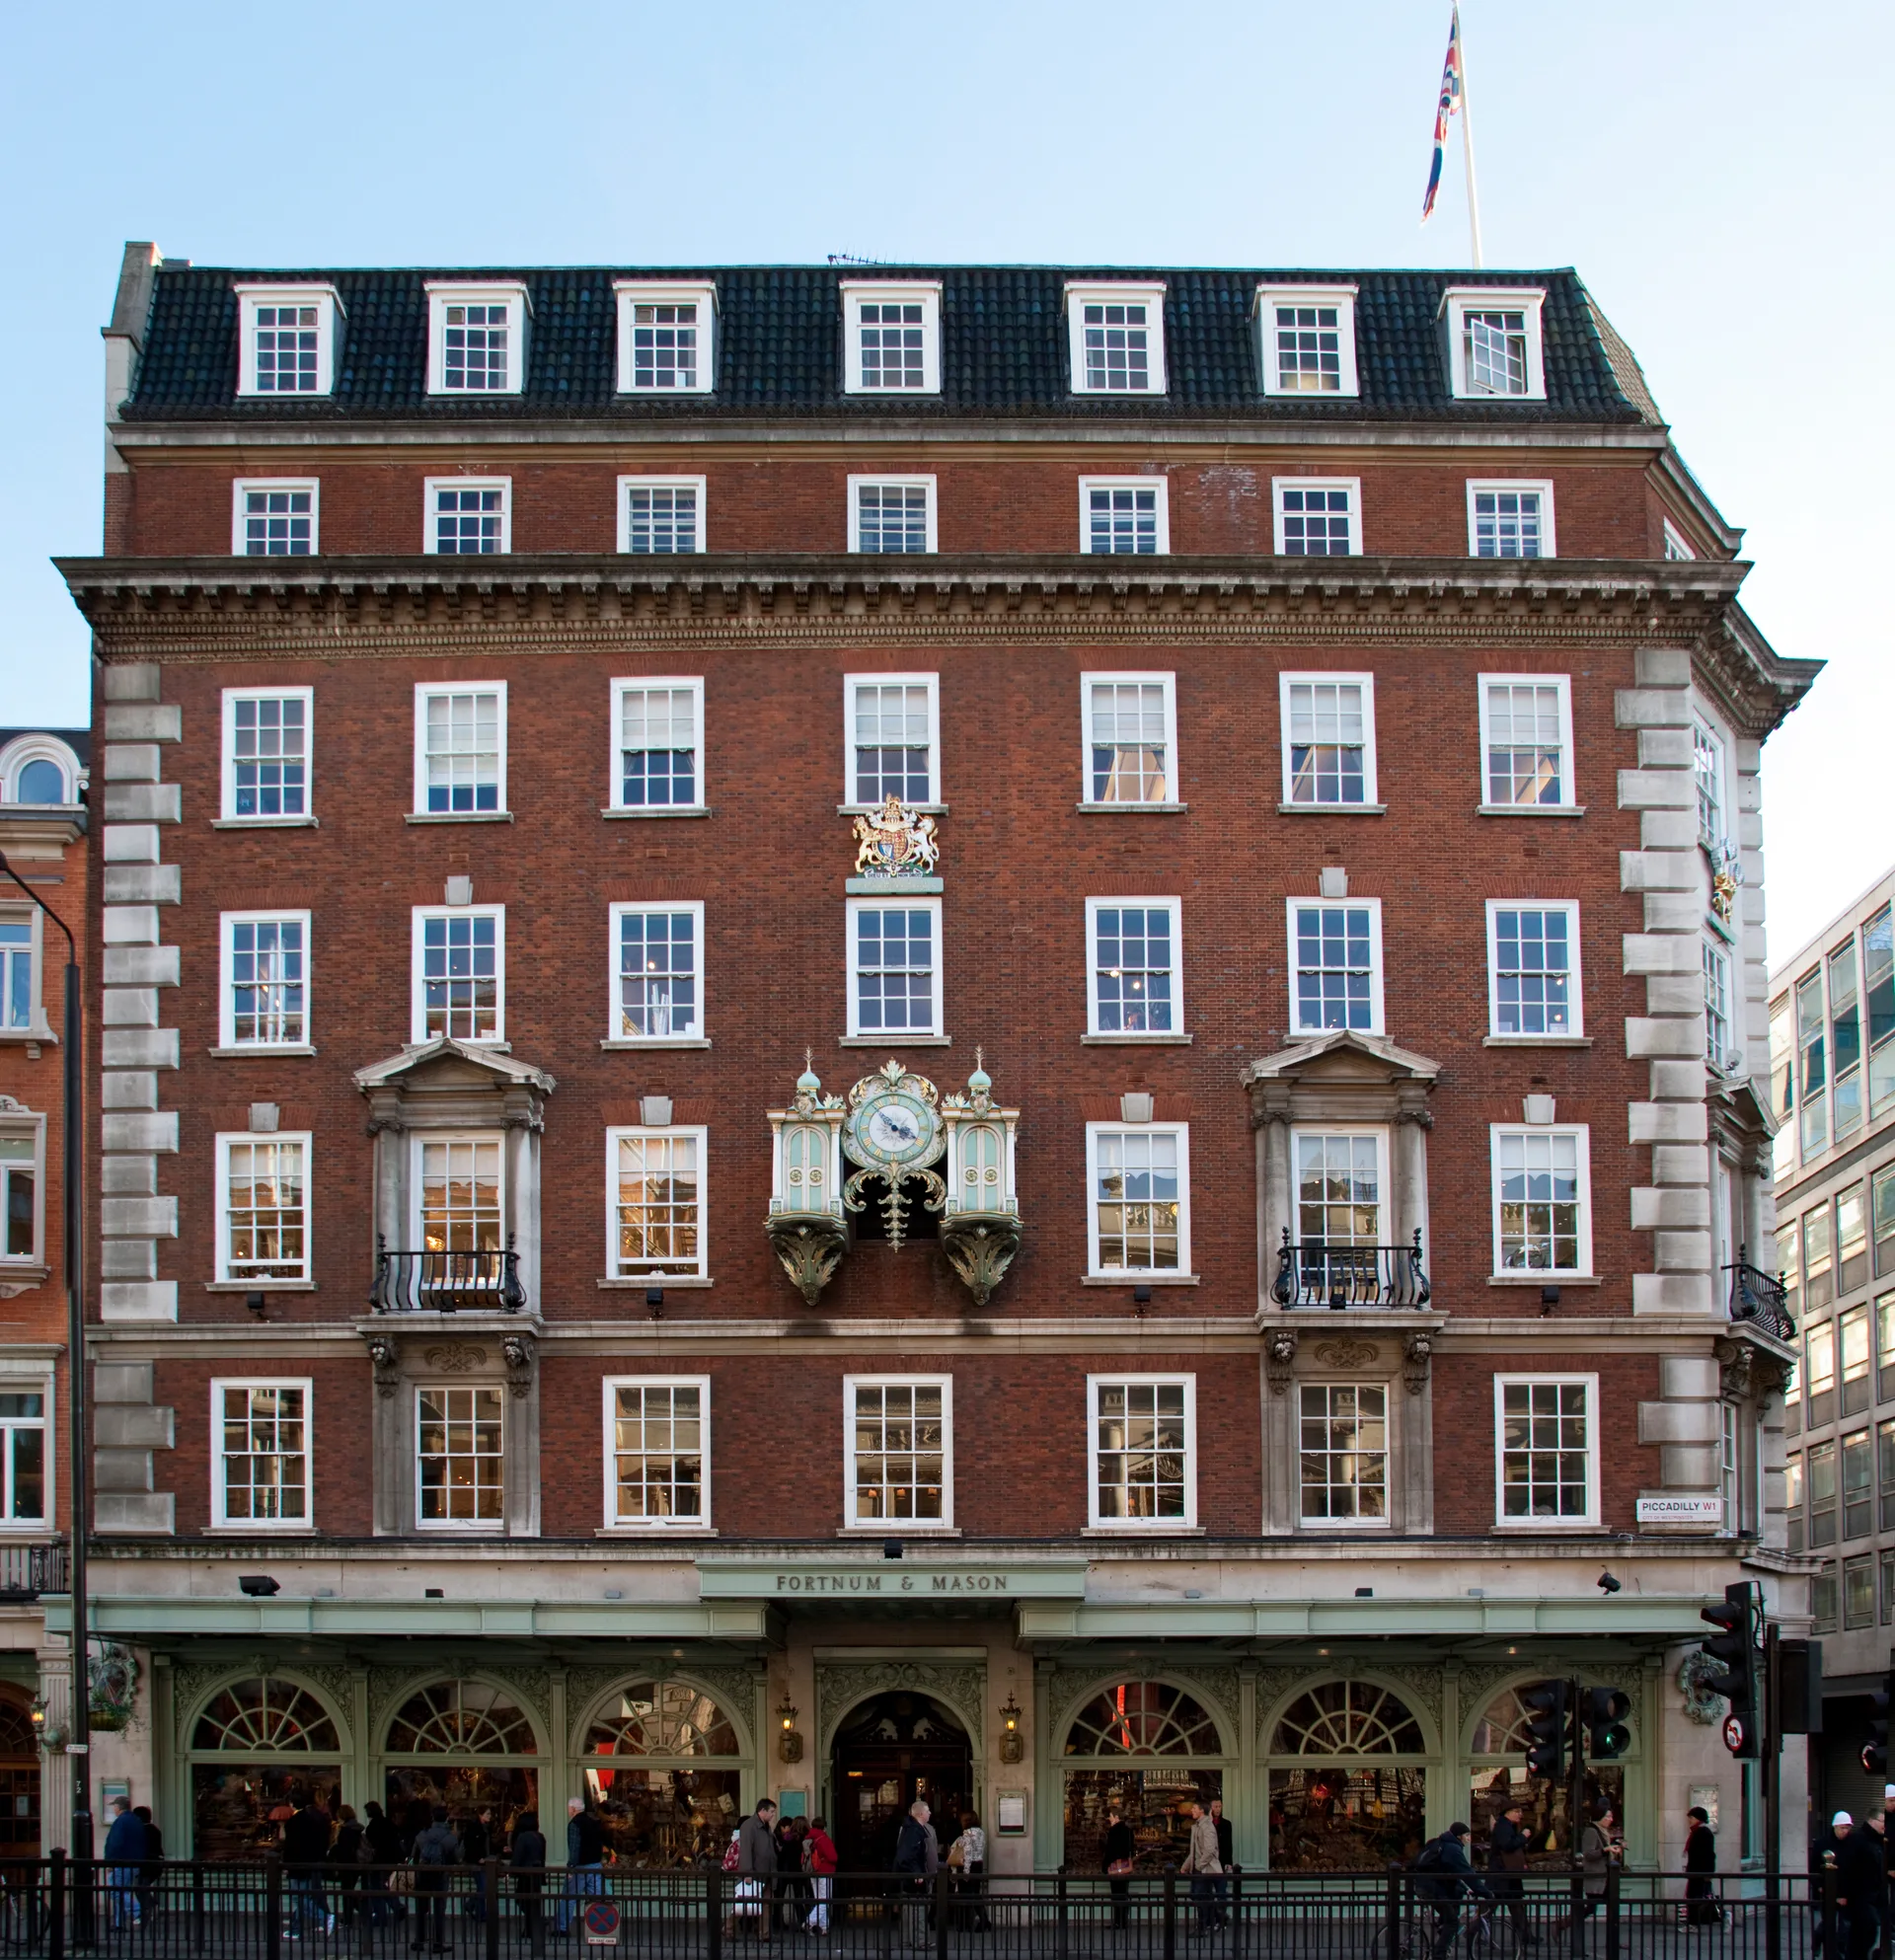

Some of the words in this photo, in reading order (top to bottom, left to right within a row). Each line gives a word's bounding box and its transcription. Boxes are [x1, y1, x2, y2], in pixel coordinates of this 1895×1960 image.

[1642, 1502, 1700, 1511] PICCADILLY
[1703, 1502, 1716, 1511] W1
[777, 1575, 881, 1591] FORTNUM
[901, 1575, 915, 1591] &
[932, 1575, 1008, 1591] MASON
